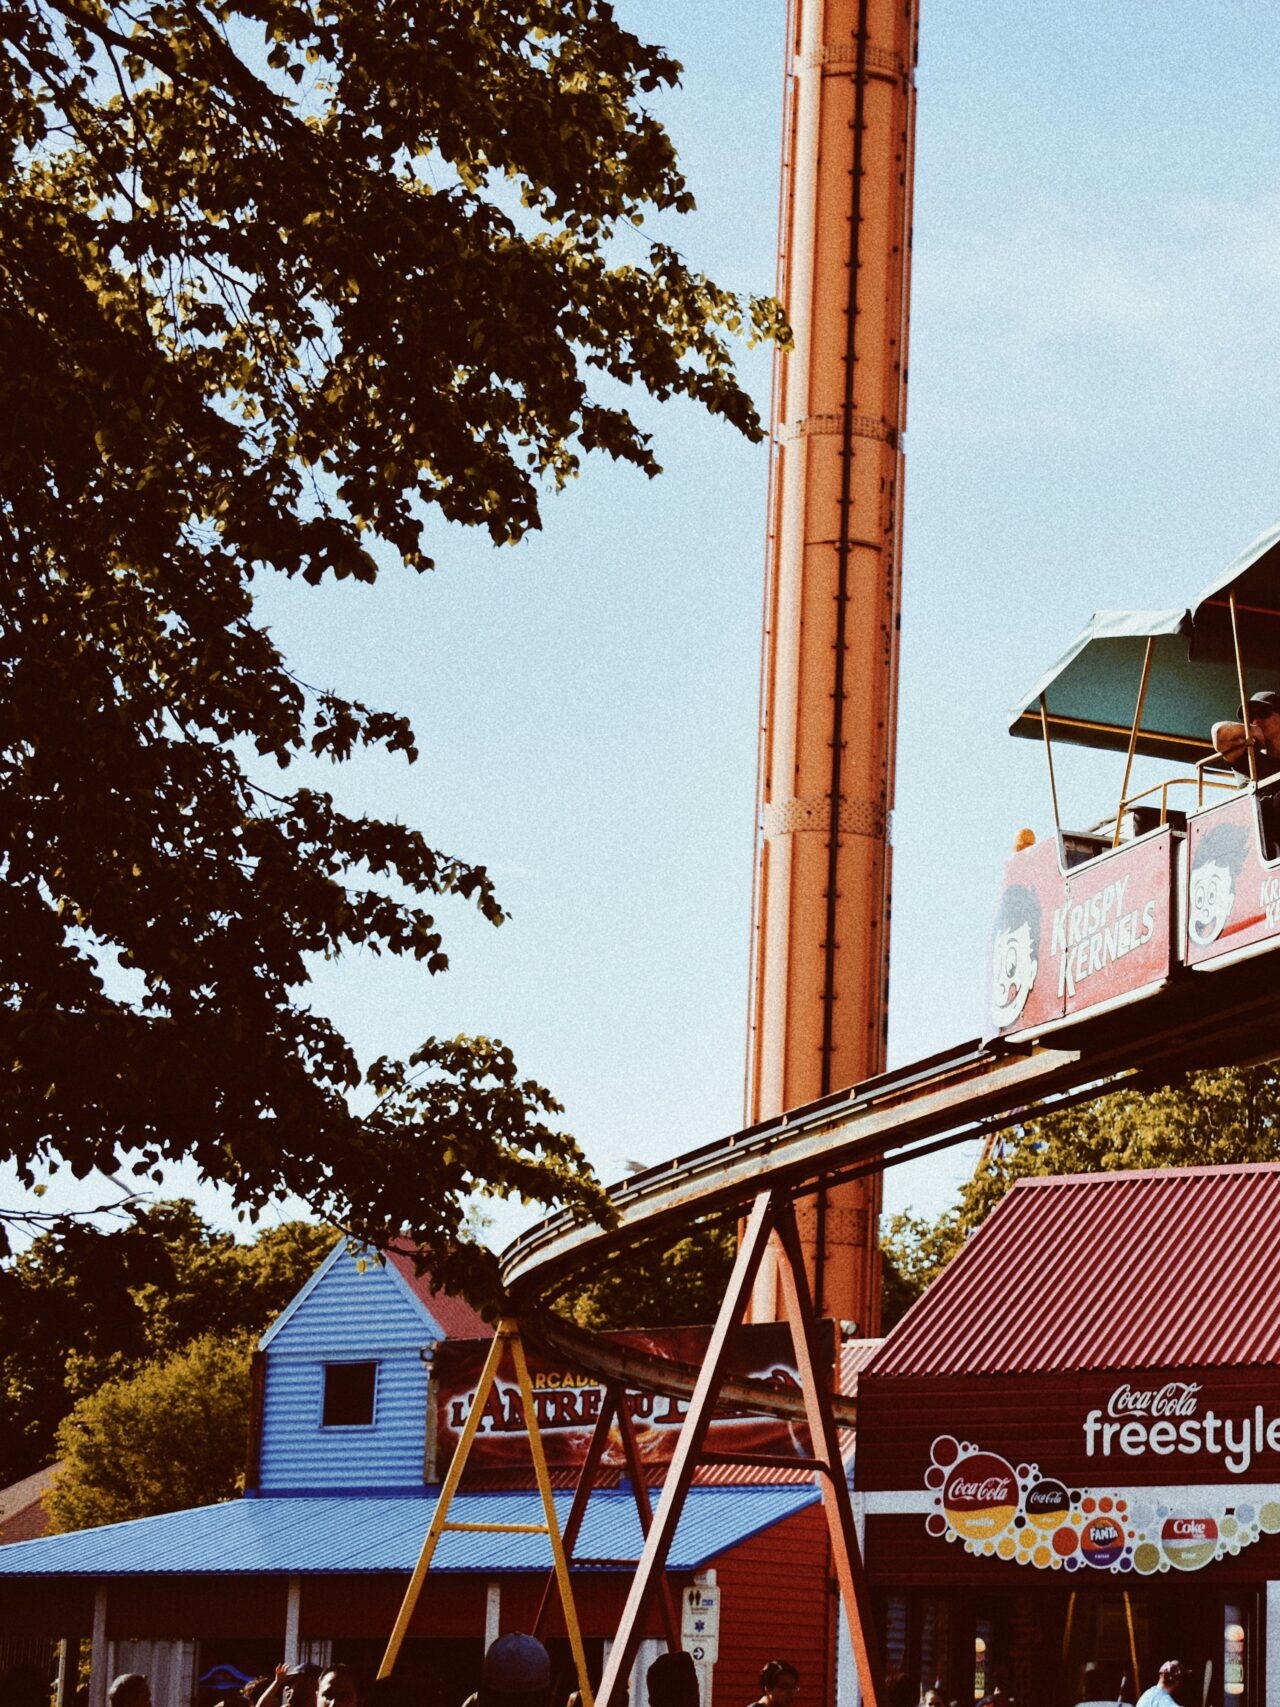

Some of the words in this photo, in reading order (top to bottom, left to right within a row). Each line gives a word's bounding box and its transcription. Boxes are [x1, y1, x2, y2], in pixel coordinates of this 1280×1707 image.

[1051, 874, 1130, 957] KRISPY
[1057, 901, 1157, 998] KERNELS
[1090, 1526, 1119, 1540] FANTA
[1173, 1520, 1206, 1534] Coke
